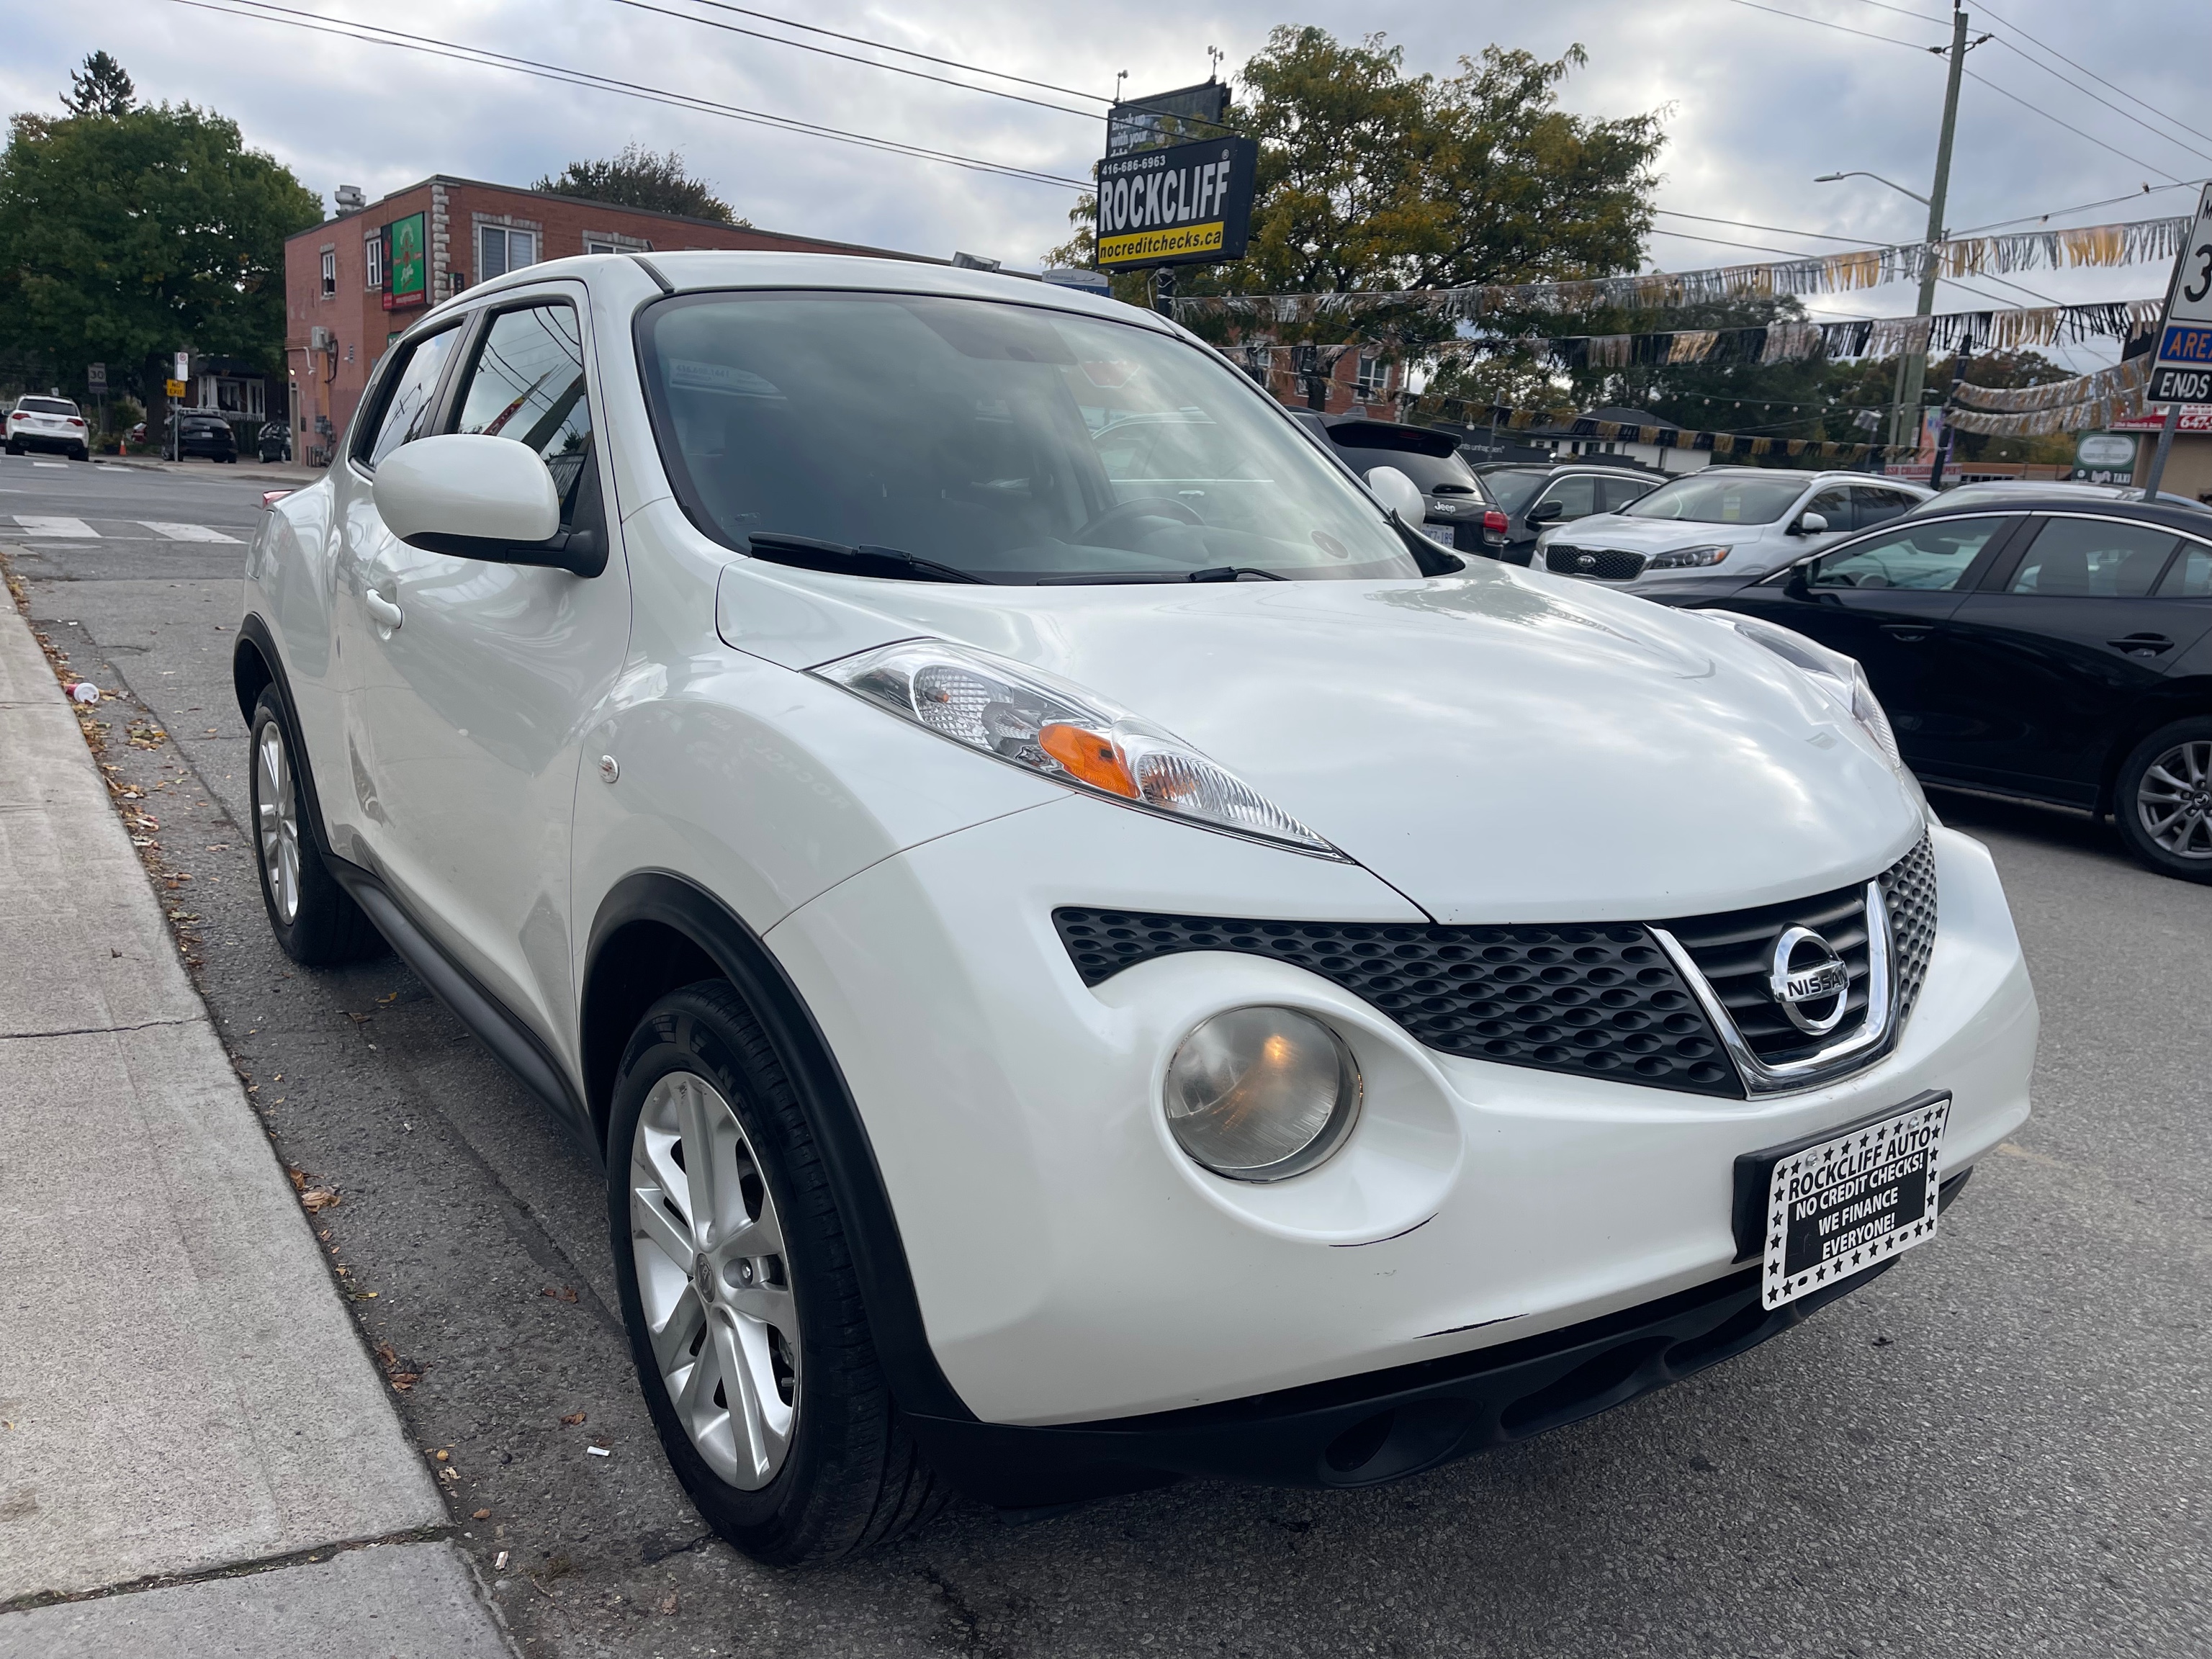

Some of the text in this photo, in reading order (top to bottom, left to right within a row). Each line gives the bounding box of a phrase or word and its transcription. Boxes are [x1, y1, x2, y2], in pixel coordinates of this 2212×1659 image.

[1110, 130, 1148, 149] with your
[1102, 154, 1166, 176] 416-686-6963
[1100, 160, 1231, 232] ROCKCLIFF
[1100, 230, 1222, 258] nocreditchecks.ca
[89, 370, 104, 379] 30
[2159, 371, 2211, 400] ENDS
[1434, 500, 1456, 514] Jeep
[1786, 969, 1847, 997] NISSAN
[1789, 1125, 1931, 1202] ROCKCLIFF AUTO
[1795, 1152, 1924, 1221] NO CREDIT CHECKS!
[1818, 1186, 1899, 1236] WE FINANCE
[1822, 1211, 1896, 1260] EVERYONE!
